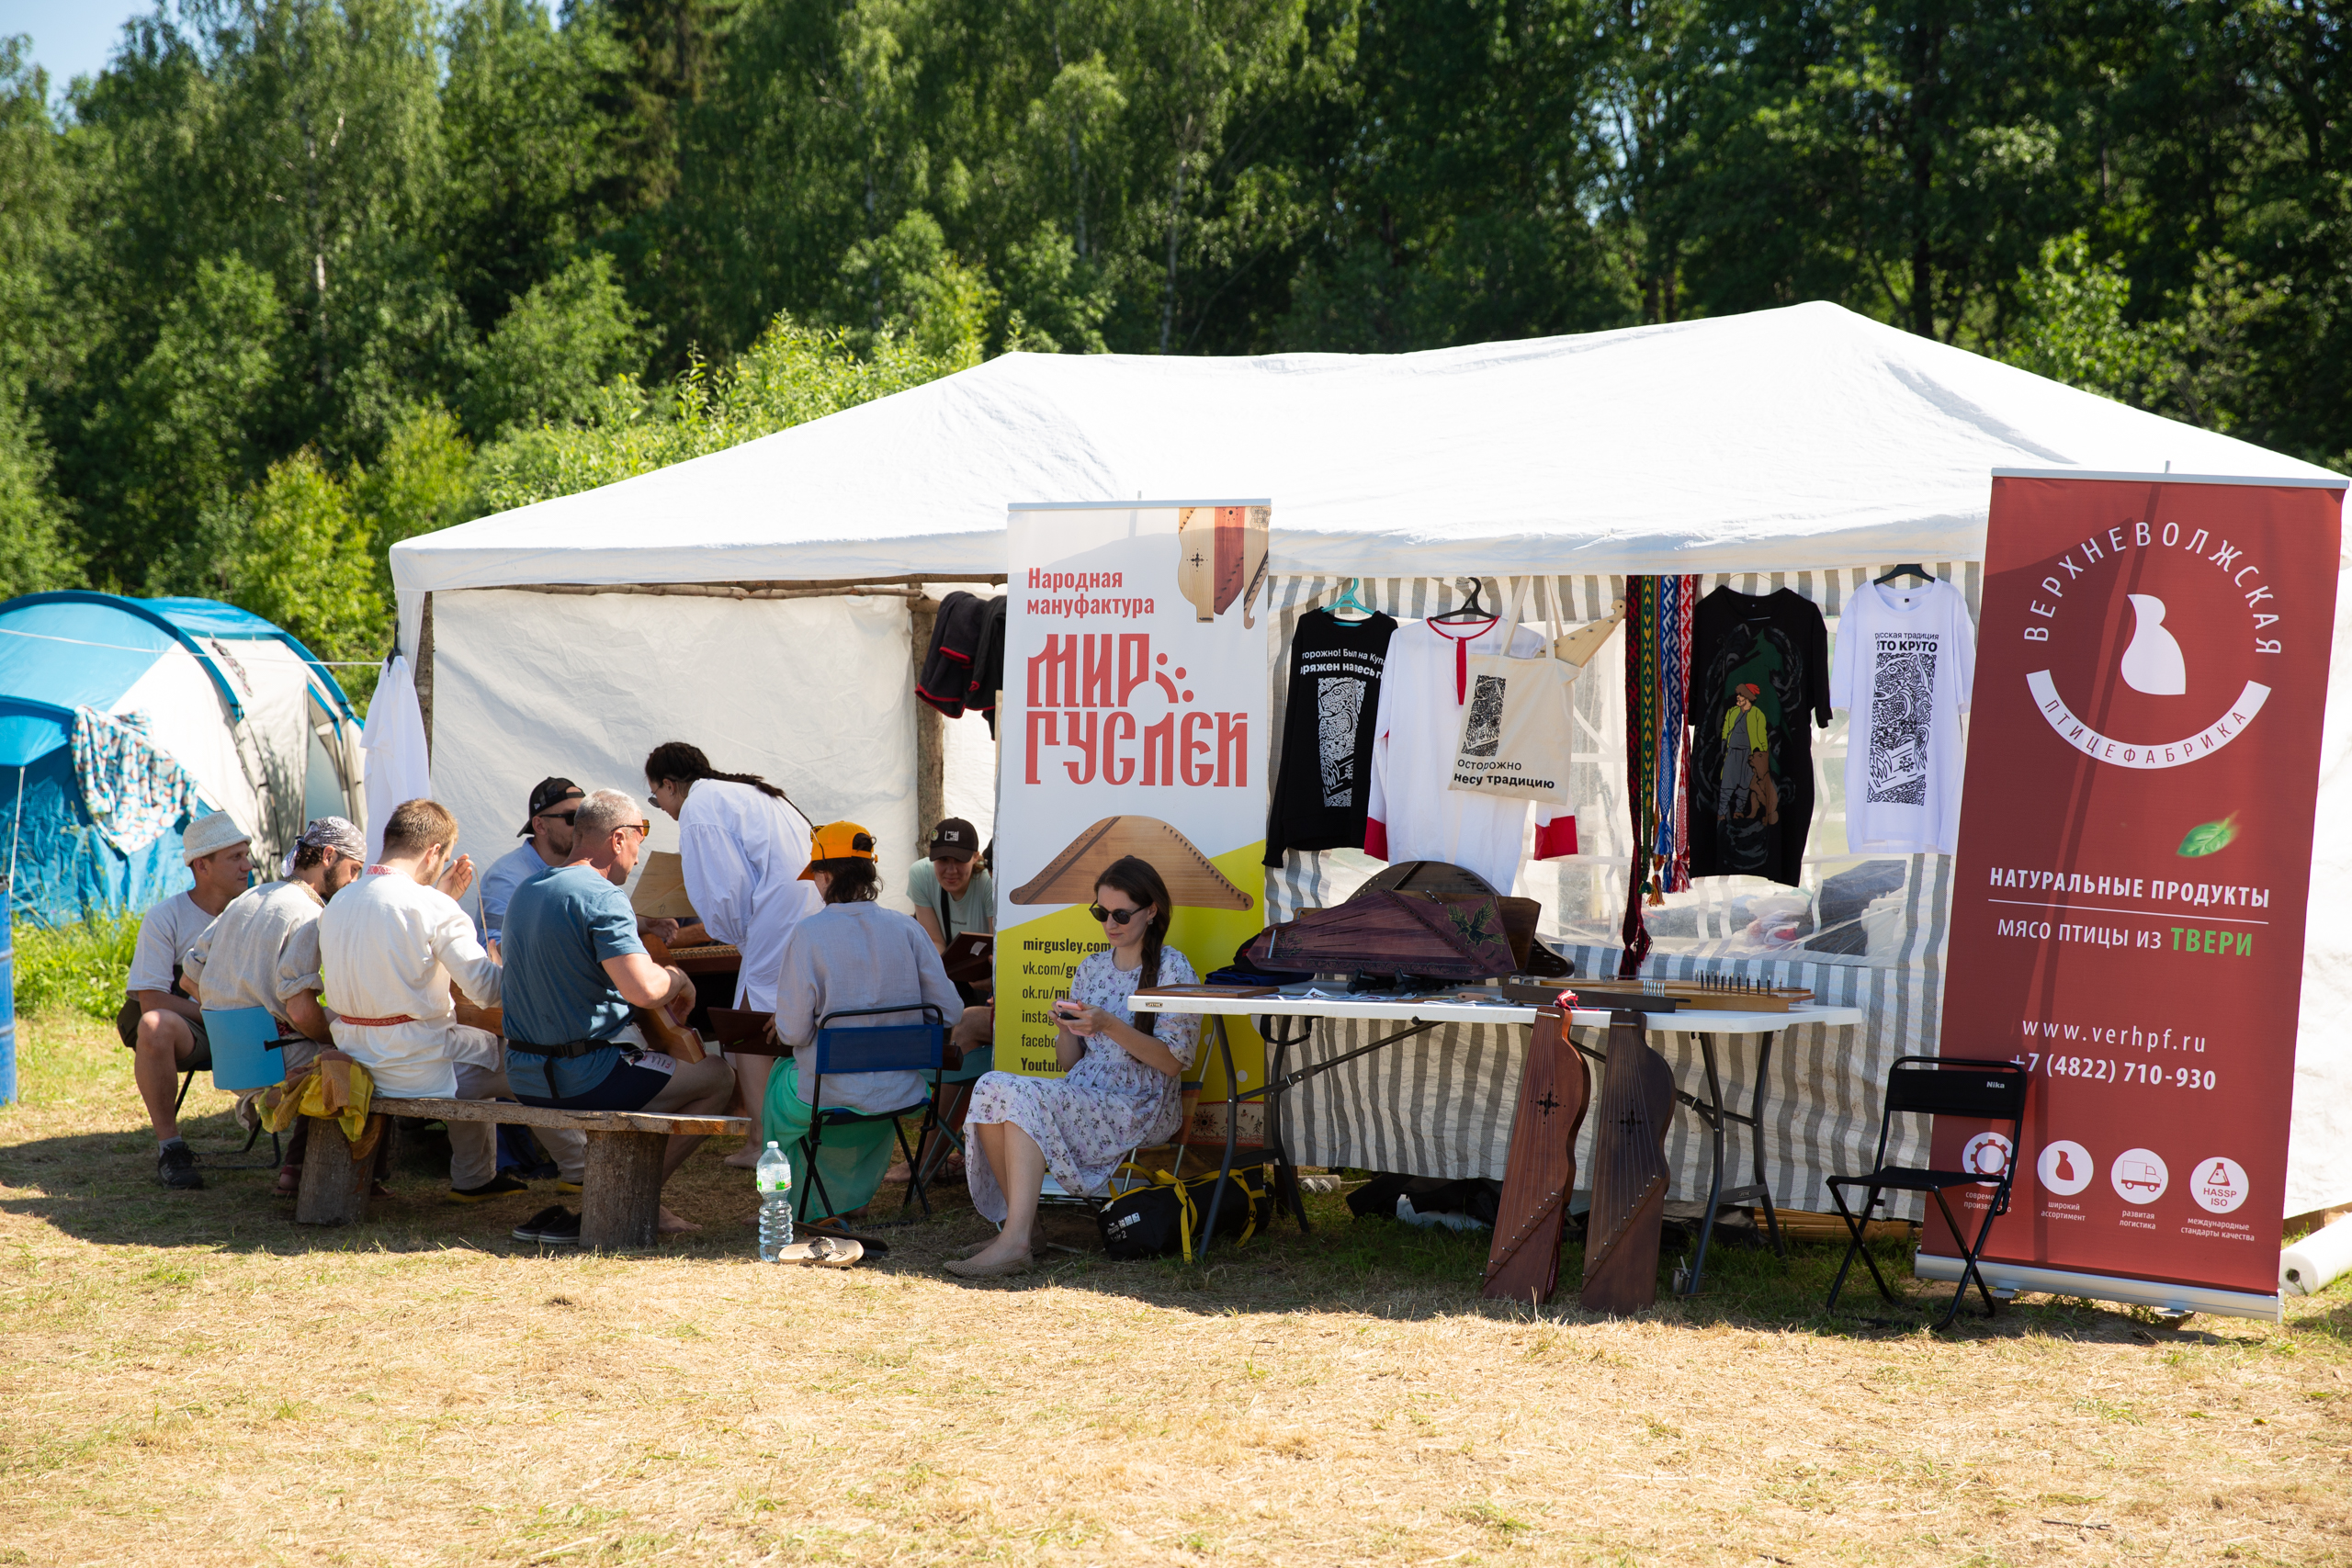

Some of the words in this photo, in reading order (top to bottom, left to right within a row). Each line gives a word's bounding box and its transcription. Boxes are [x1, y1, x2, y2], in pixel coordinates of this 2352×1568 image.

[1028, 568, 1123, 592] Народная
[2024, 522, 2281, 653] ВЕРХНЕВОЛЖСКАЯ
[1027, 593, 1155, 618] мануфактура
[1899, 641, 1938, 652] КРУТО
[1343, 649, 1357, 657] Был
[1370, 653, 1385, 665] Куп
[1026, 633, 1150, 707] МИР
[2045, 700, 2246, 764] ПТИЦЕФАБРИКА
[1025, 711, 1248, 787] ГУСЛЕЙ
[1453, 773, 1483, 785] несу
[1487, 775, 1555, 789] традицию
[1989, 867, 2143, 898] НАТУРАЛЬНЫЕ
[2151, 881, 2269, 908] ПРОДУКТЫ
[1023, 937, 1112, 954] mirgusley.com
[1997, 919, 2052, 940] МЯСО
[2058, 923, 2129, 949] ПТИЦЫ
[2136, 931, 2162, 949] ИЗ
[2171, 928, 2253, 956] ТВЕРИ
[2022, 1020, 2206, 1053] www.verhpf.ru
[1021, 1057, 1069, 1073] Youtub
[2010, 1053, 2040, 1072] +7
[2046, 1054, 2116, 1084] (4822)
[2124, 1063, 2216, 1090] 710-930
[2203, 1188, 2237, 1198] HASSP
[2048, 1201, 2080, 1211] широкий
[2211, 1198, 2228, 1206] ISO
[2041, 1210, 2086, 1221] ассортимент
[2121, 1210, 2155, 1220] развитая
[2119, 1220, 2156, 1230] логистика
[2188, 1218, 2249, 1231] международные
[2180, 1226, 2220, 1237] стандарты
[2222, 1231, 2255, 1241] качества
